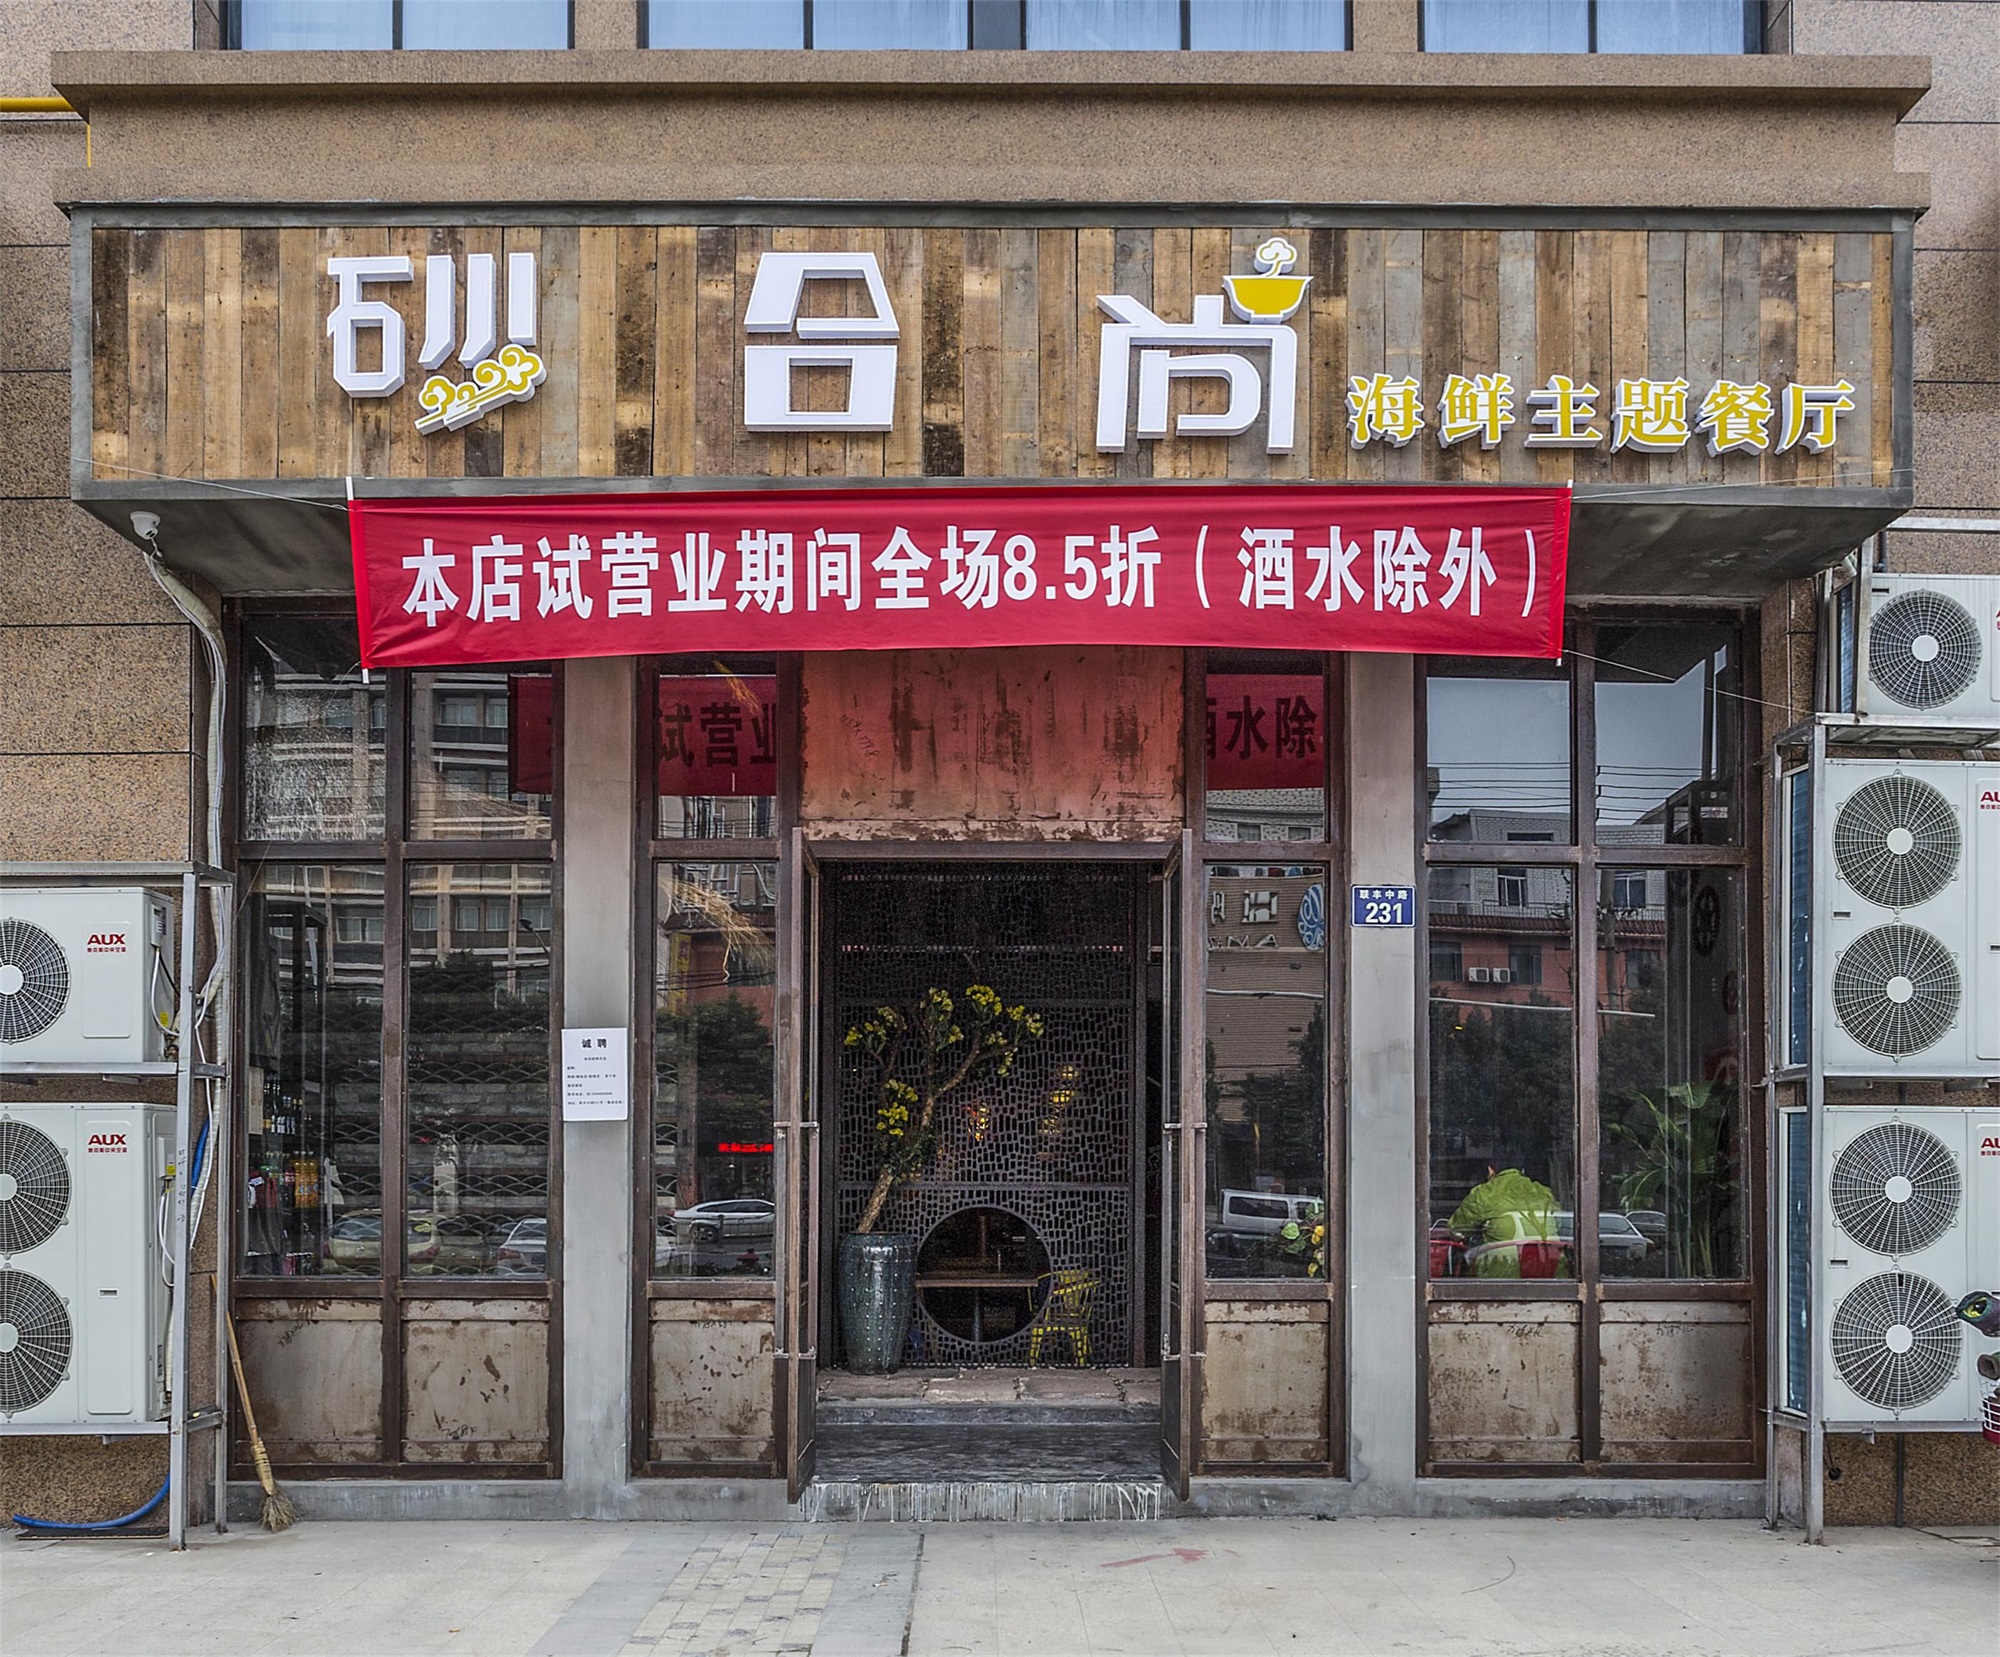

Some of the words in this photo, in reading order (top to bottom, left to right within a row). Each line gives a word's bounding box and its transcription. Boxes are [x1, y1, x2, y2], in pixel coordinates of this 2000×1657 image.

[1346, 373, 1856, 455] 海鲜主题餐厅
[1207, 695, 1318, 760] 水除
[1365, 902, 1402, 924] 231
[87, 934, 126, 945] AUX
[88, 1134, 127, 1145] AUX
